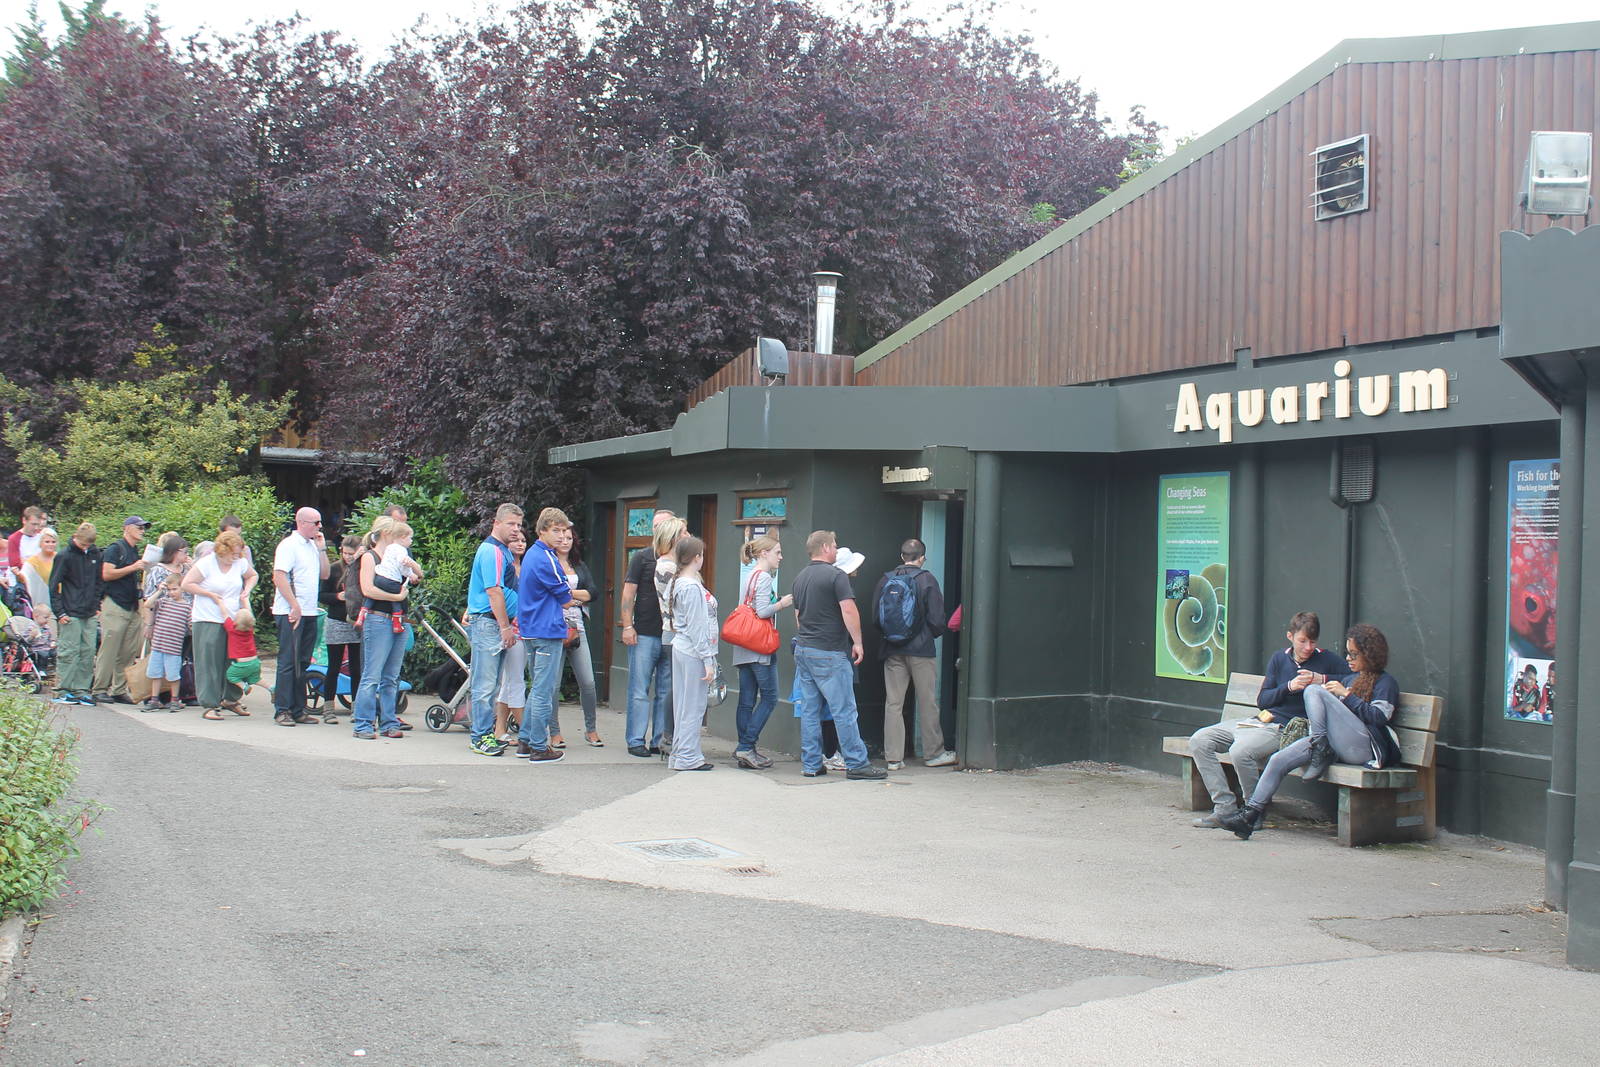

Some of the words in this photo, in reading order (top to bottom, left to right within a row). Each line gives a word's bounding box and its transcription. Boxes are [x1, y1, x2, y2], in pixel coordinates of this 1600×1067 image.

[1173, 359, 1448, 443] Aquarium
[1517, 470, 1534, 481] Fish
[1536, 470, 1548, 481] for
[1167, 487, 1192, 500] Changing
[1193, 486, 1207, 497] Seas
